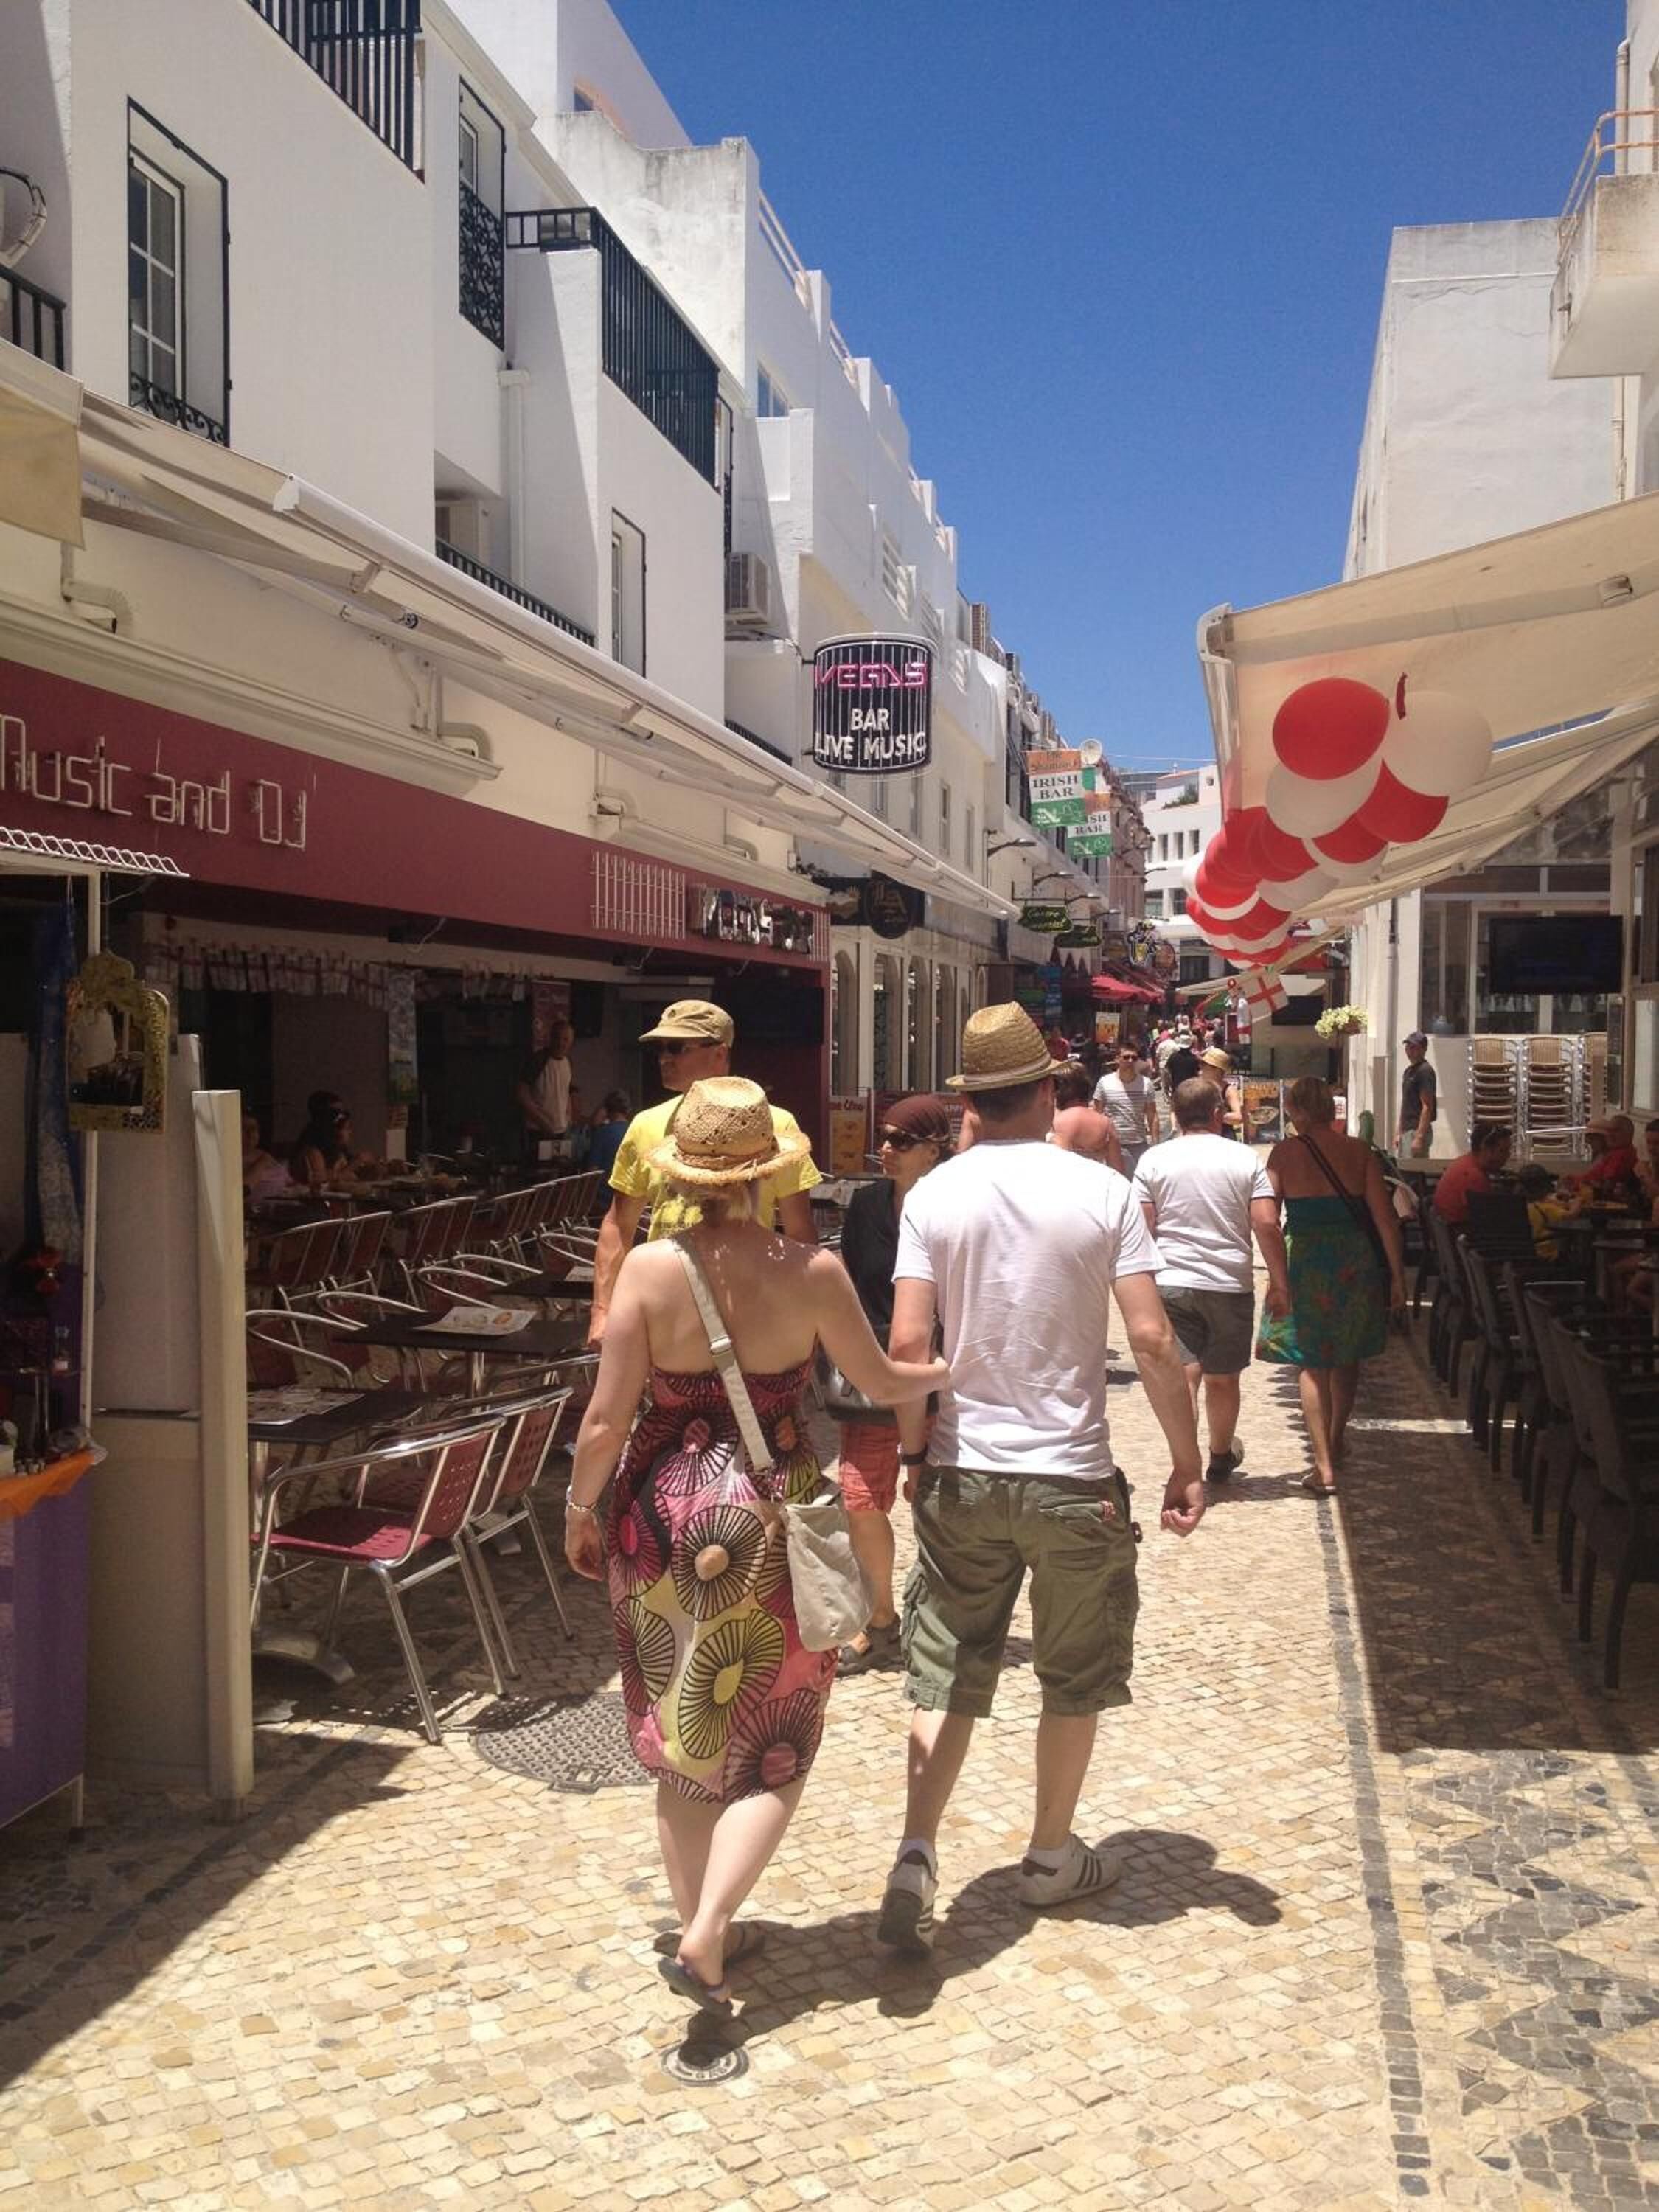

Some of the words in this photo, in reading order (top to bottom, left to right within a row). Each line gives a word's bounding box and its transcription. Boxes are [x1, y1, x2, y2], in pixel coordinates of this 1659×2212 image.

[815, 663, 926, 689] VEGAS
[850, 708, 890, 731] BAR
[815, 732, 855, 760] LIVE
[863, 731, 928, 760] MUSIC
[0, 714, 133, 816] Music
[147, 769, 230, 835] and
[257, 778, 307, 850] DJ
[1033, 774, 1078, 788] IRISH
[1040, 787, 1074, 799] BAR
[1075, 824, 1103, 835] BAR
